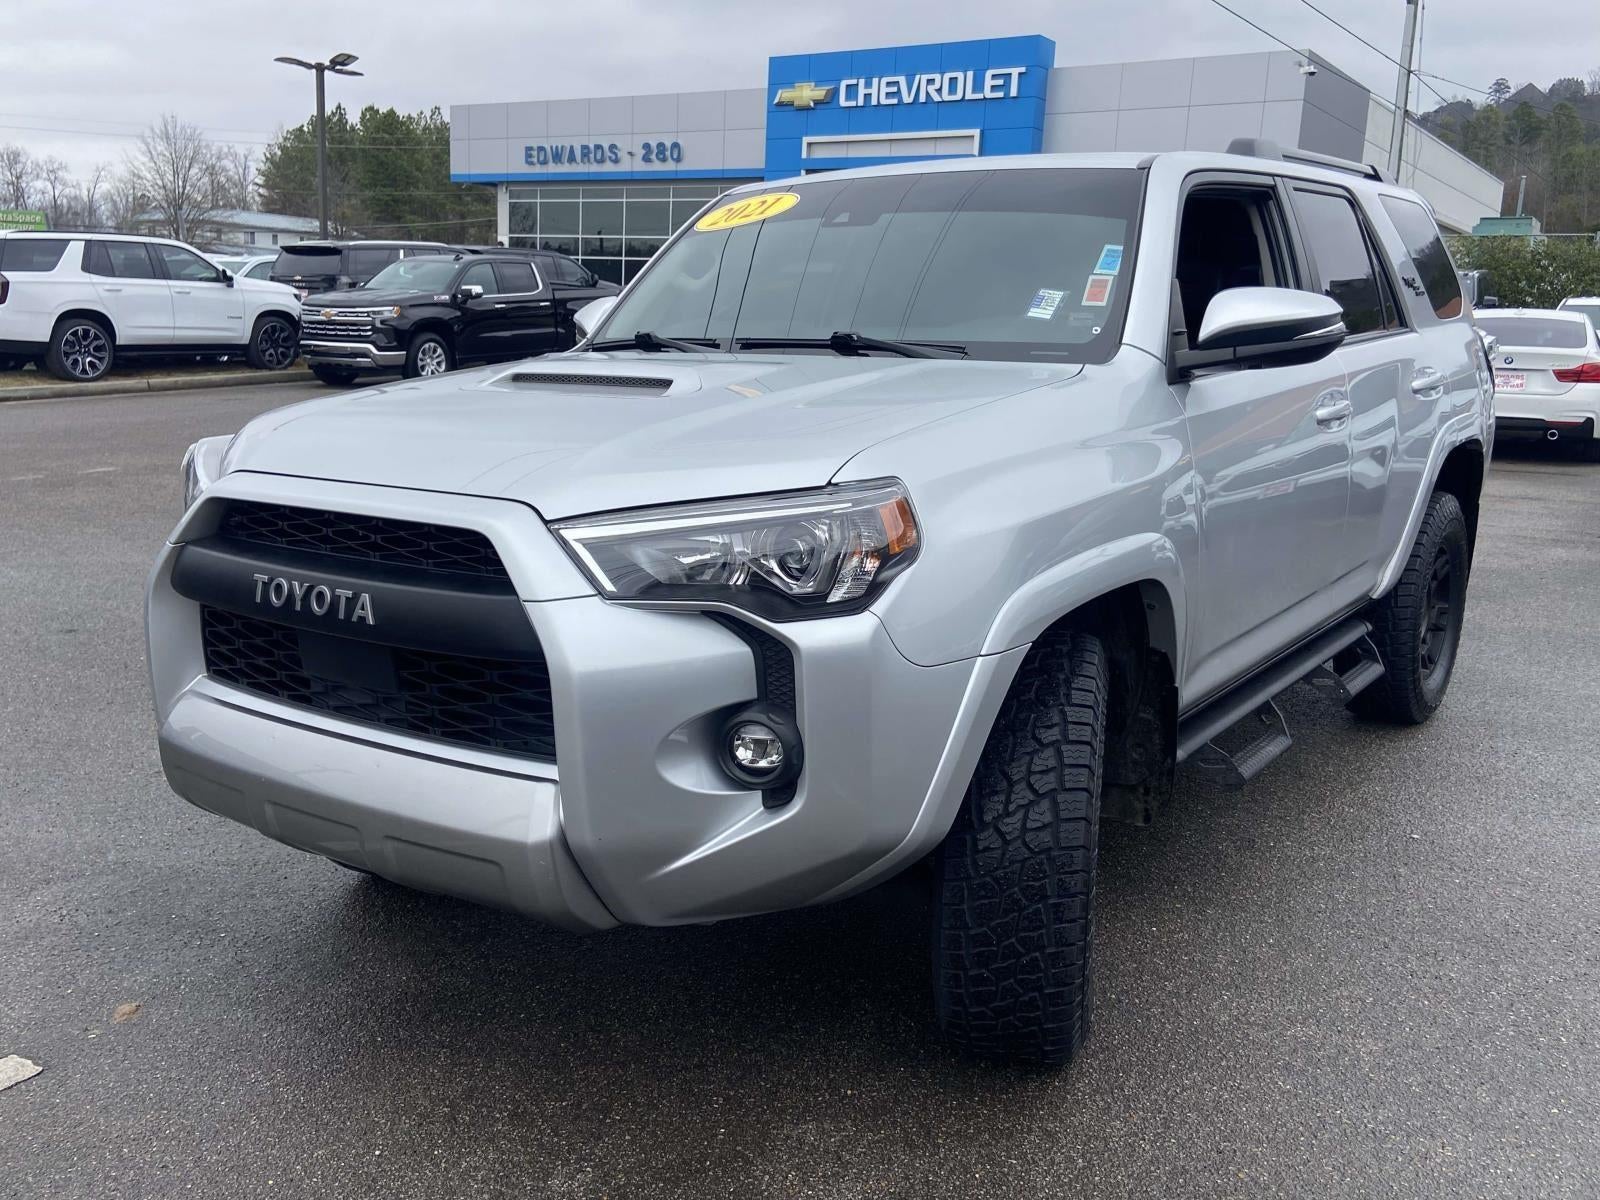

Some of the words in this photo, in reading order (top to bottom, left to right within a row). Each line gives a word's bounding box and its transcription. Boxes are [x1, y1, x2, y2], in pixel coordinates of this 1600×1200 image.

[839, 66, 1026, 108] CHEVROLET
[524, 143, 621, 166] EDWARDS
[641, 141, 684, 164] 280
[705, 196, 784, 228] 2021
[253, 573, 376, 626] TOYOTA
